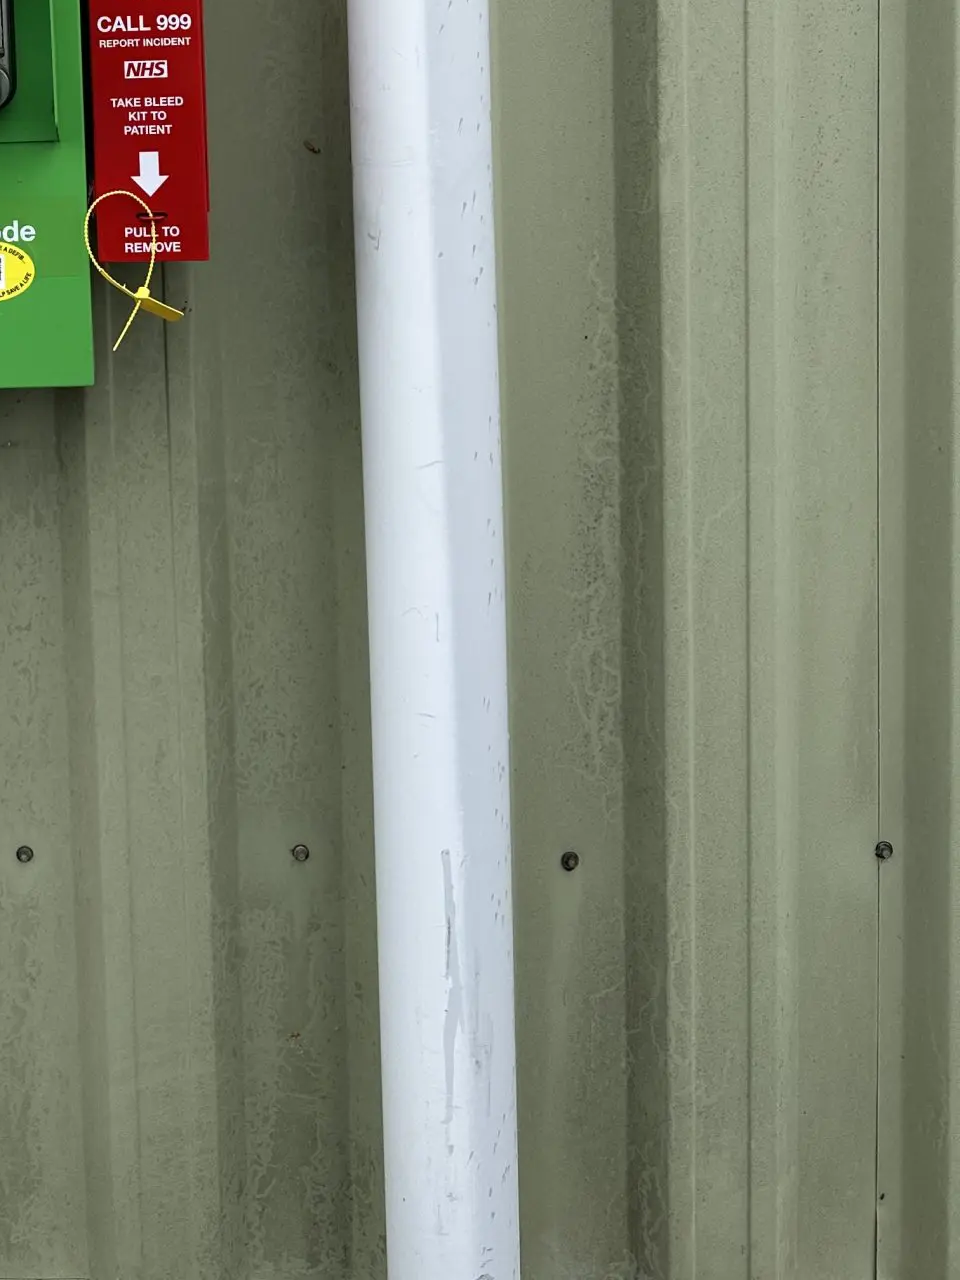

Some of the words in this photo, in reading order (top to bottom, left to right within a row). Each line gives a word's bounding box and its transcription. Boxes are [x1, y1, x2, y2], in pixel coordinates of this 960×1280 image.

[97, 15, 151, 32] CALL
[156, 14, 192, 31] 999
[99, 39, 140, 48] REPORT
[143, 37, 191, 47] INCIDENT
[125, 61, 166, 77] NHS
[110, 98, 141, 108] TAKE
[144, 96, 184, 107] BLEED
[128, 111, 148, 121] KIT
[150, 111, 167, 121] TO
[124, 124, 173, 135] PATIENT
[162, 226, 180, 237] TO
[124, 242, 181, 253] REMOVE
[6, 285, 20, 296] SAVE
[23, 272, 32, 284] LIFE
